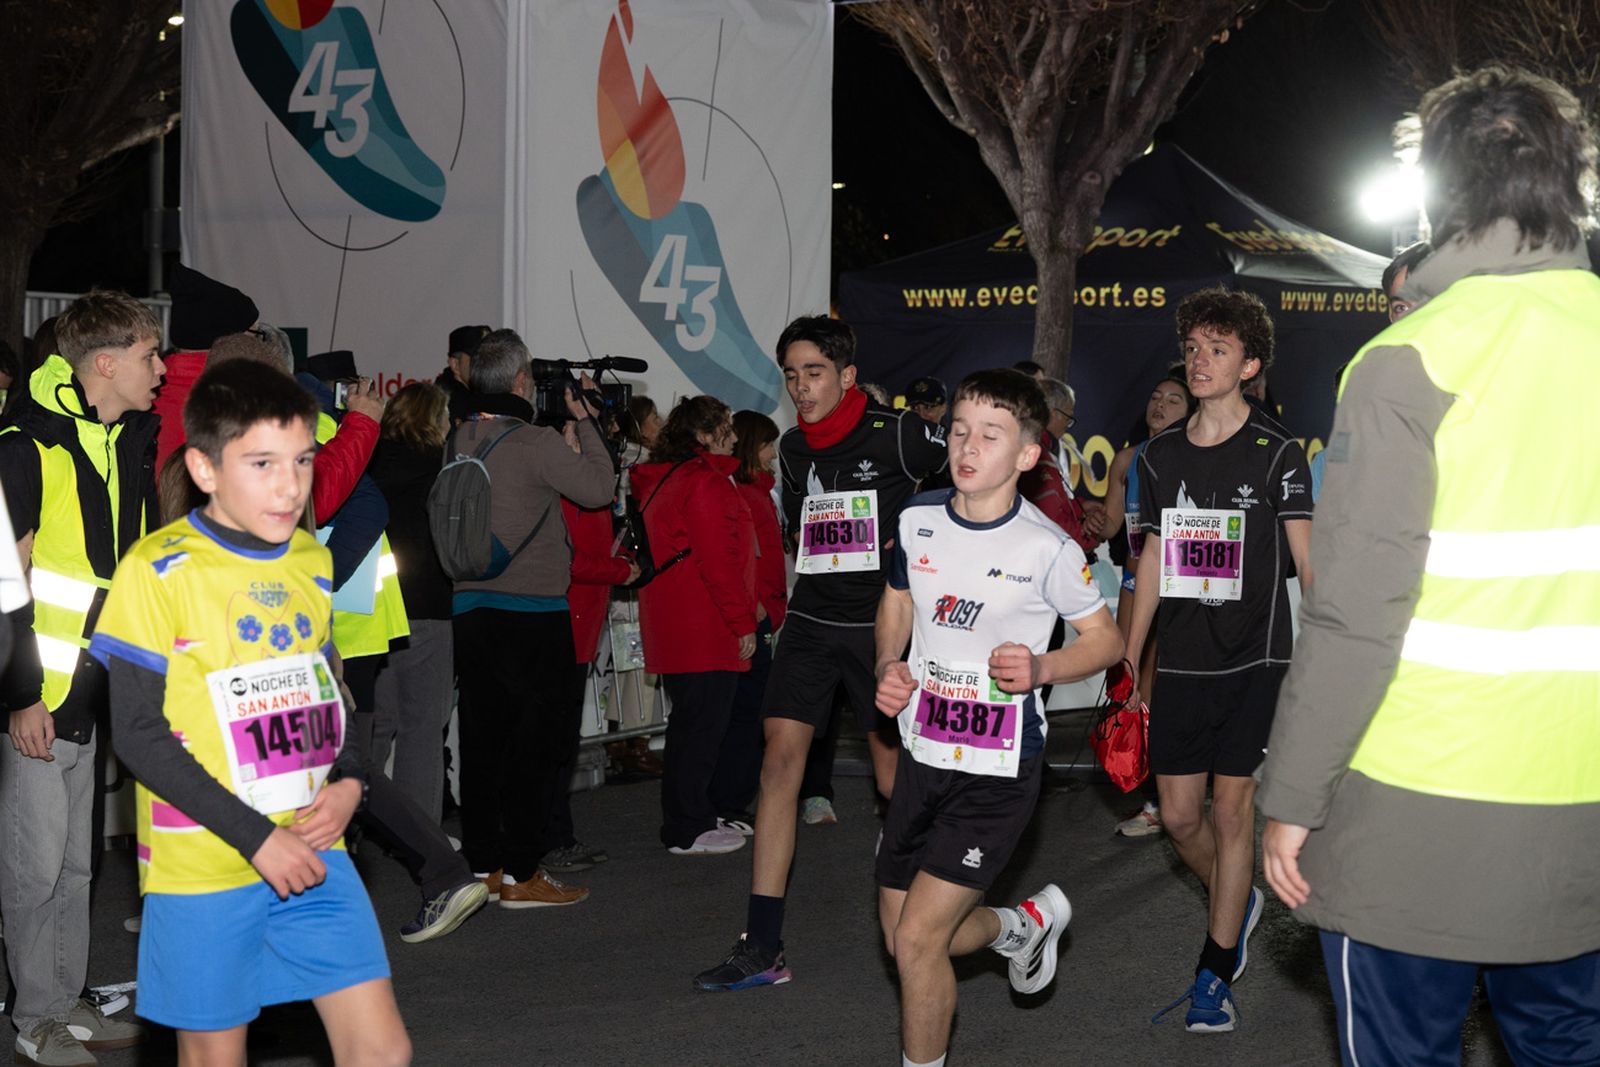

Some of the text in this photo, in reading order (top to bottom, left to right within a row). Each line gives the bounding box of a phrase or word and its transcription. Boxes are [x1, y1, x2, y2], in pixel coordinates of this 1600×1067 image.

[288, 41, 377, 158] 43
[639, 234, 721, 352] 43
[1281, 289, 1388, 312] www.evede
[816, 502, 834, 511] NOCHE
[809, 521, 868, 546] 14630
[1172, 529, 1191, 539] SAN
[1184, 519, 1221, 528] NOCHE DE
[1178, 541, 1235, 568] 15181
[1005, 574, 1032, 584] mupol
[251, 675, 294, 694] NOCHE
[295, 672, 309, 687] DE
[965, 674, 979, 687] DE
[237, 697, 268, 717] SAN
[926, 697, 1006, 737] 14387
[245, 705, 336, 761] 14504
